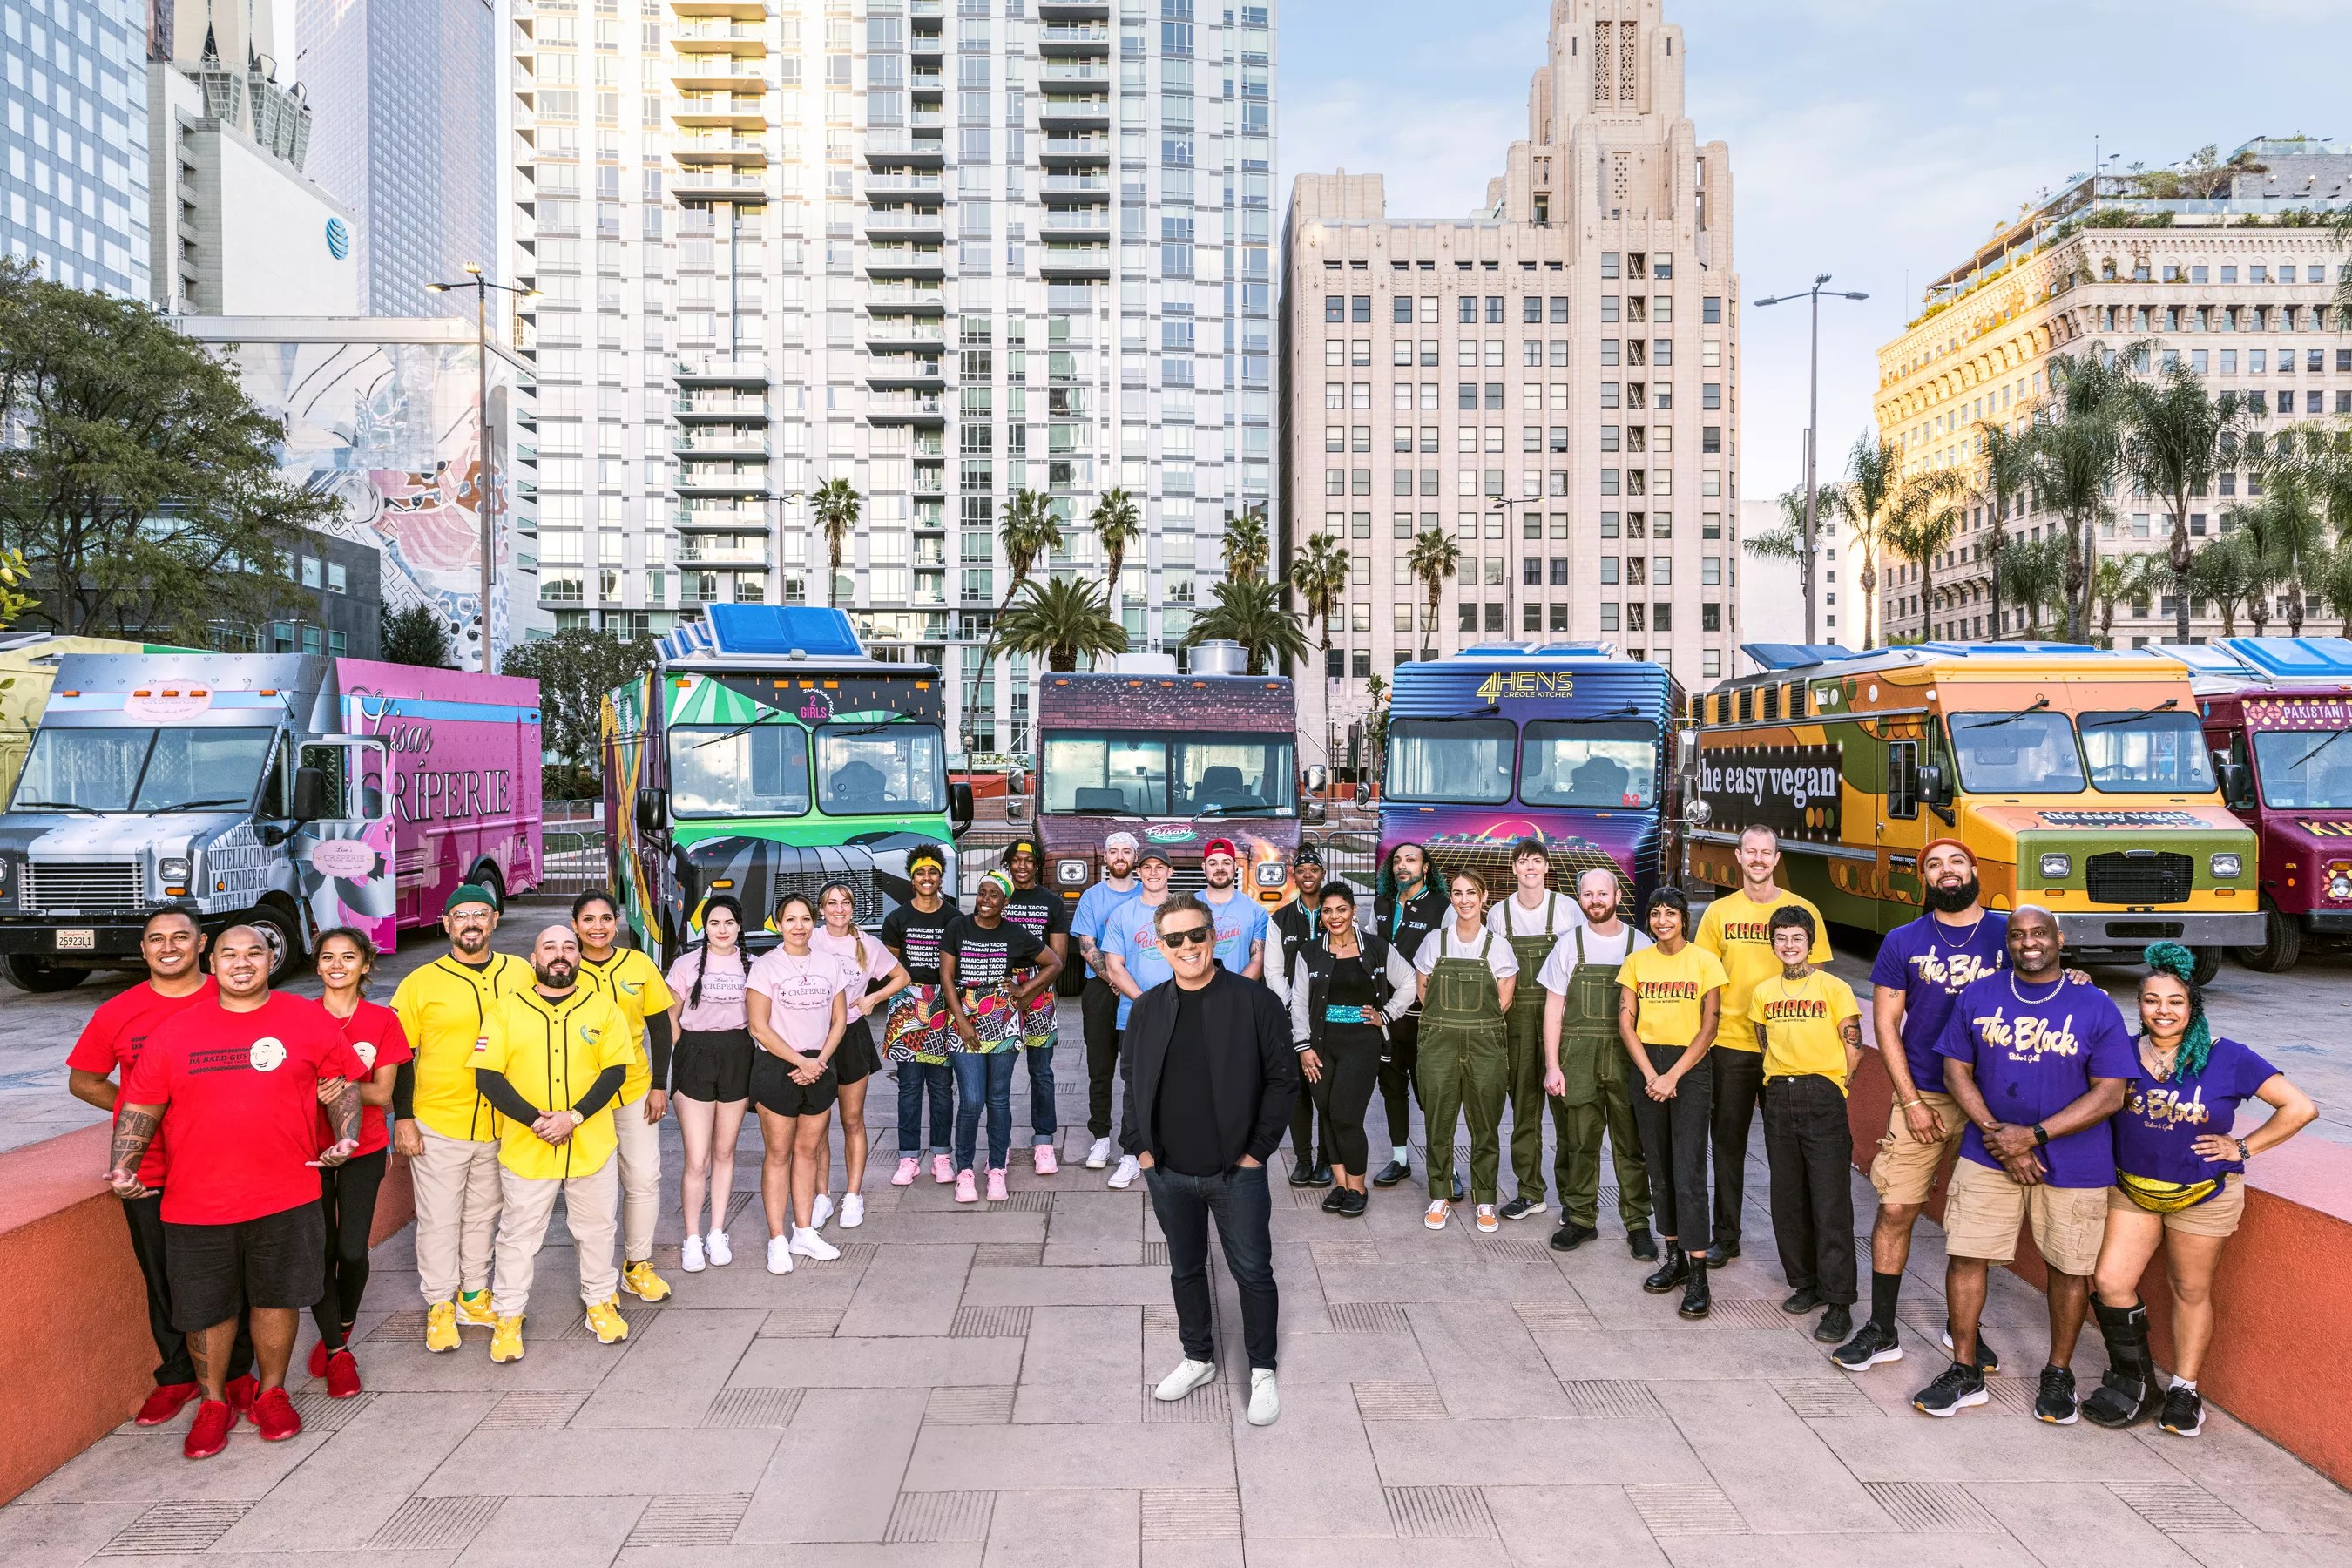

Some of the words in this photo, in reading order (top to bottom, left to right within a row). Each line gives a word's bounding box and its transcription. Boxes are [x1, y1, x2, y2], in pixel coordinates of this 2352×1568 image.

[802, 687, 831, 700] JAMAICAN
[809, 695, 816, 706] 2
[800, 706, 827, 719] GIRLS
[2283, 706, 2344, 718] PAKISTANI
[1725, 767, 1767, 806] easy
[1769, 767, 1837, 809] vegan
[1409, 921, 1427, 930] ZEN
[1725, 923, 1771, 941] KHA
[59, 936, 91, 946] 25923L1
[1909, 945, 1948, 984] The
[1947, 950, 2003, 986] Blo
[1637, 981, 1699, 1000] KHANA
[1763, 1000, 1827, 1020] KHANA
[1973, 1006, 2013, 1047] The
[2014, 1014, 2078, 1057] Block
[2146, 1085, 2209, 1125] Block
